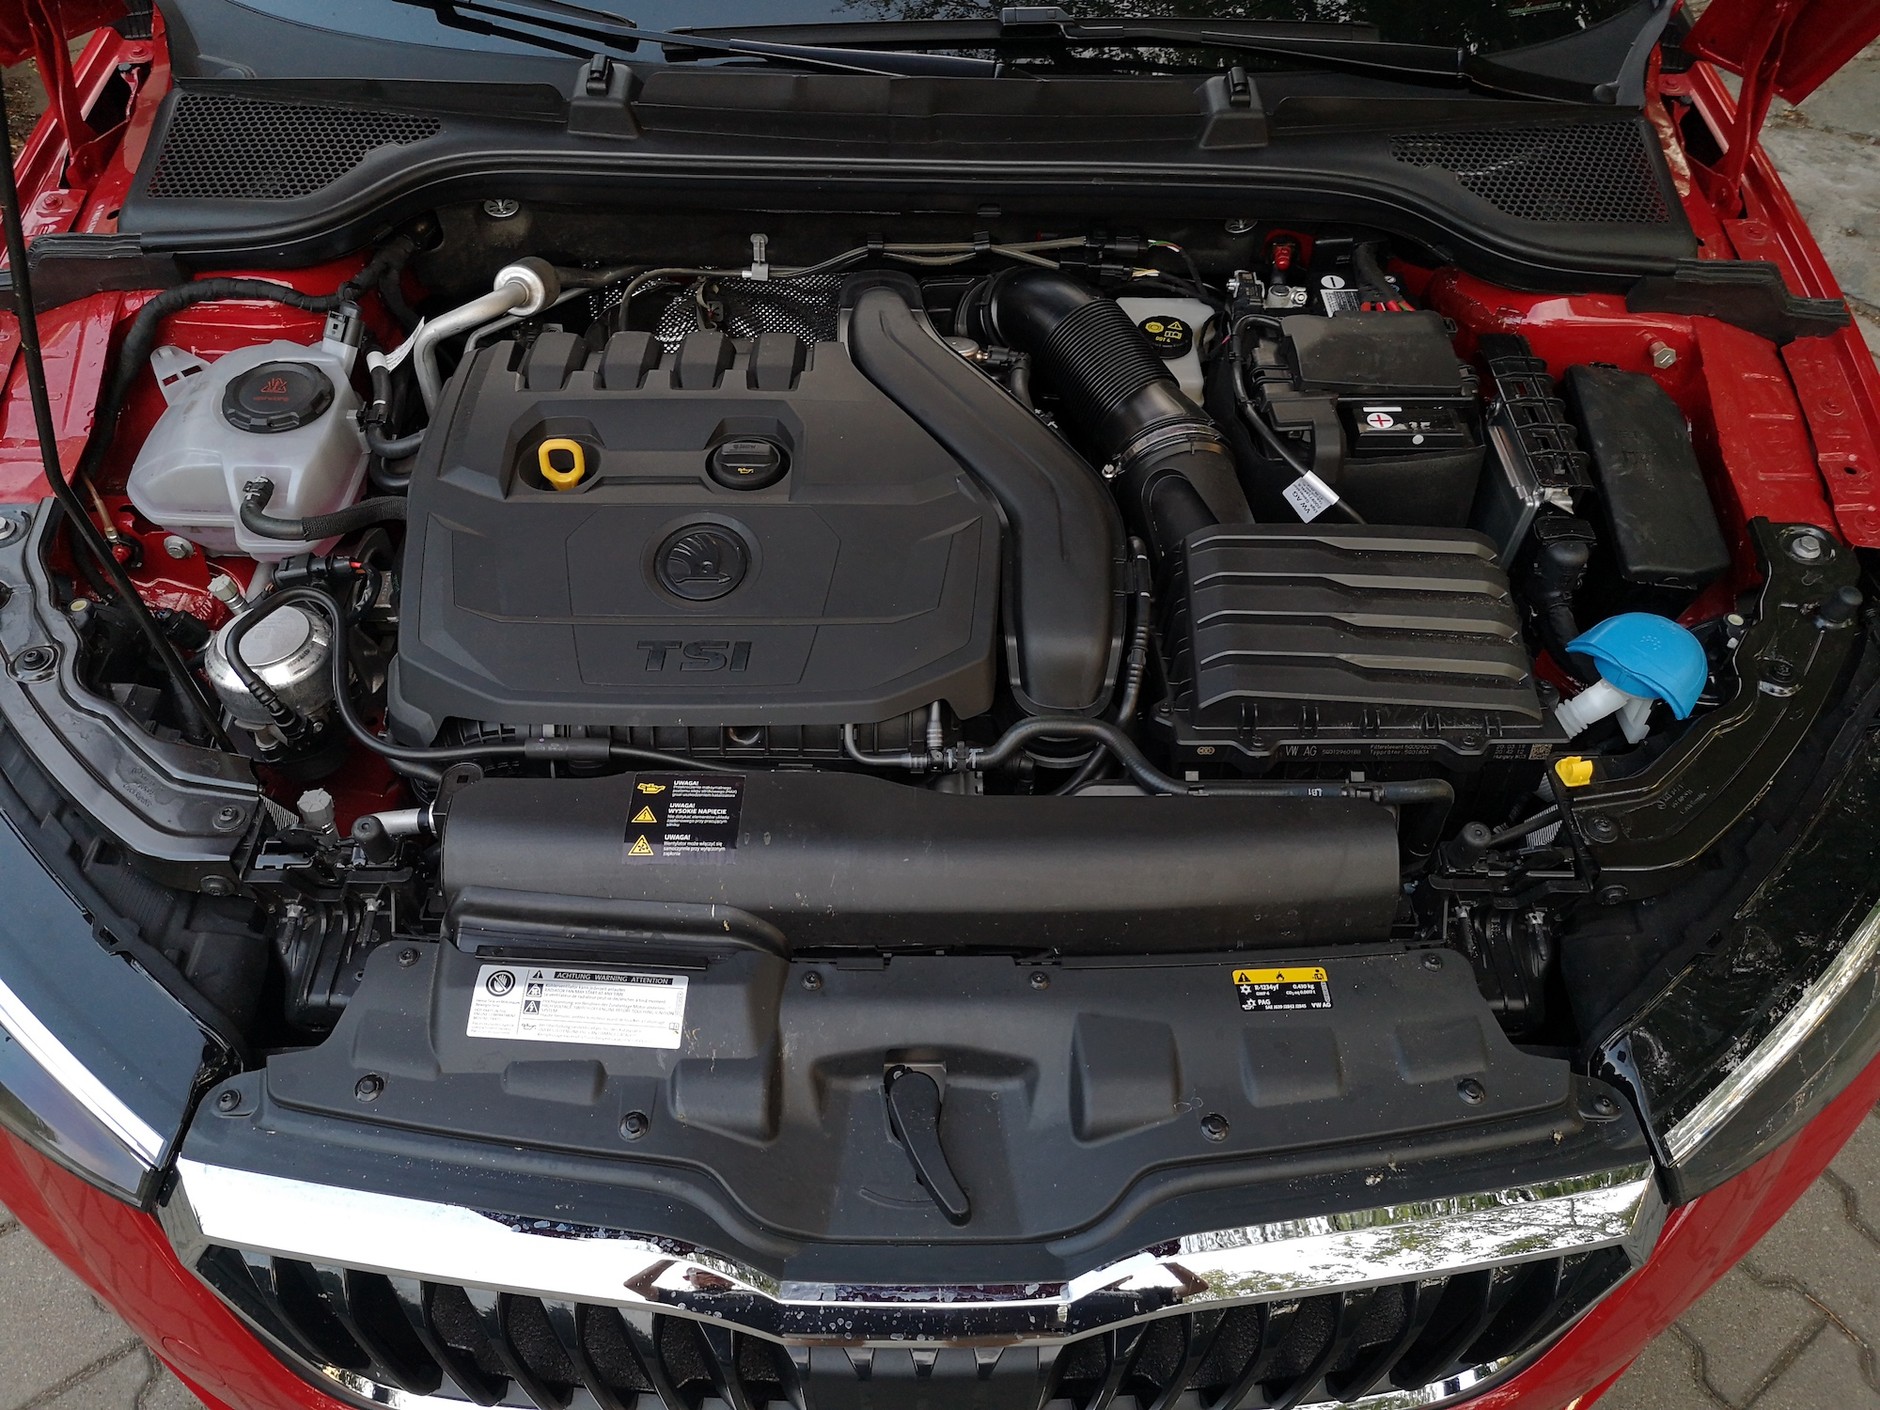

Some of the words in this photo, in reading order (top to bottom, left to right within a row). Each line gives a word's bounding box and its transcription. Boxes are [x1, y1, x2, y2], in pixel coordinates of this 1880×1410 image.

[1292, 491, 1302, 501] AG
[1300, 502, 1310, 514] VW
[637, 640, 752, 672] TSI
[1285, 745, 1300, 757] VW
[1302, 745, 1318, 757] AG
[556, 972, 591, 980] ACHTUNG
[594, 974, 628, 982] WARNING
